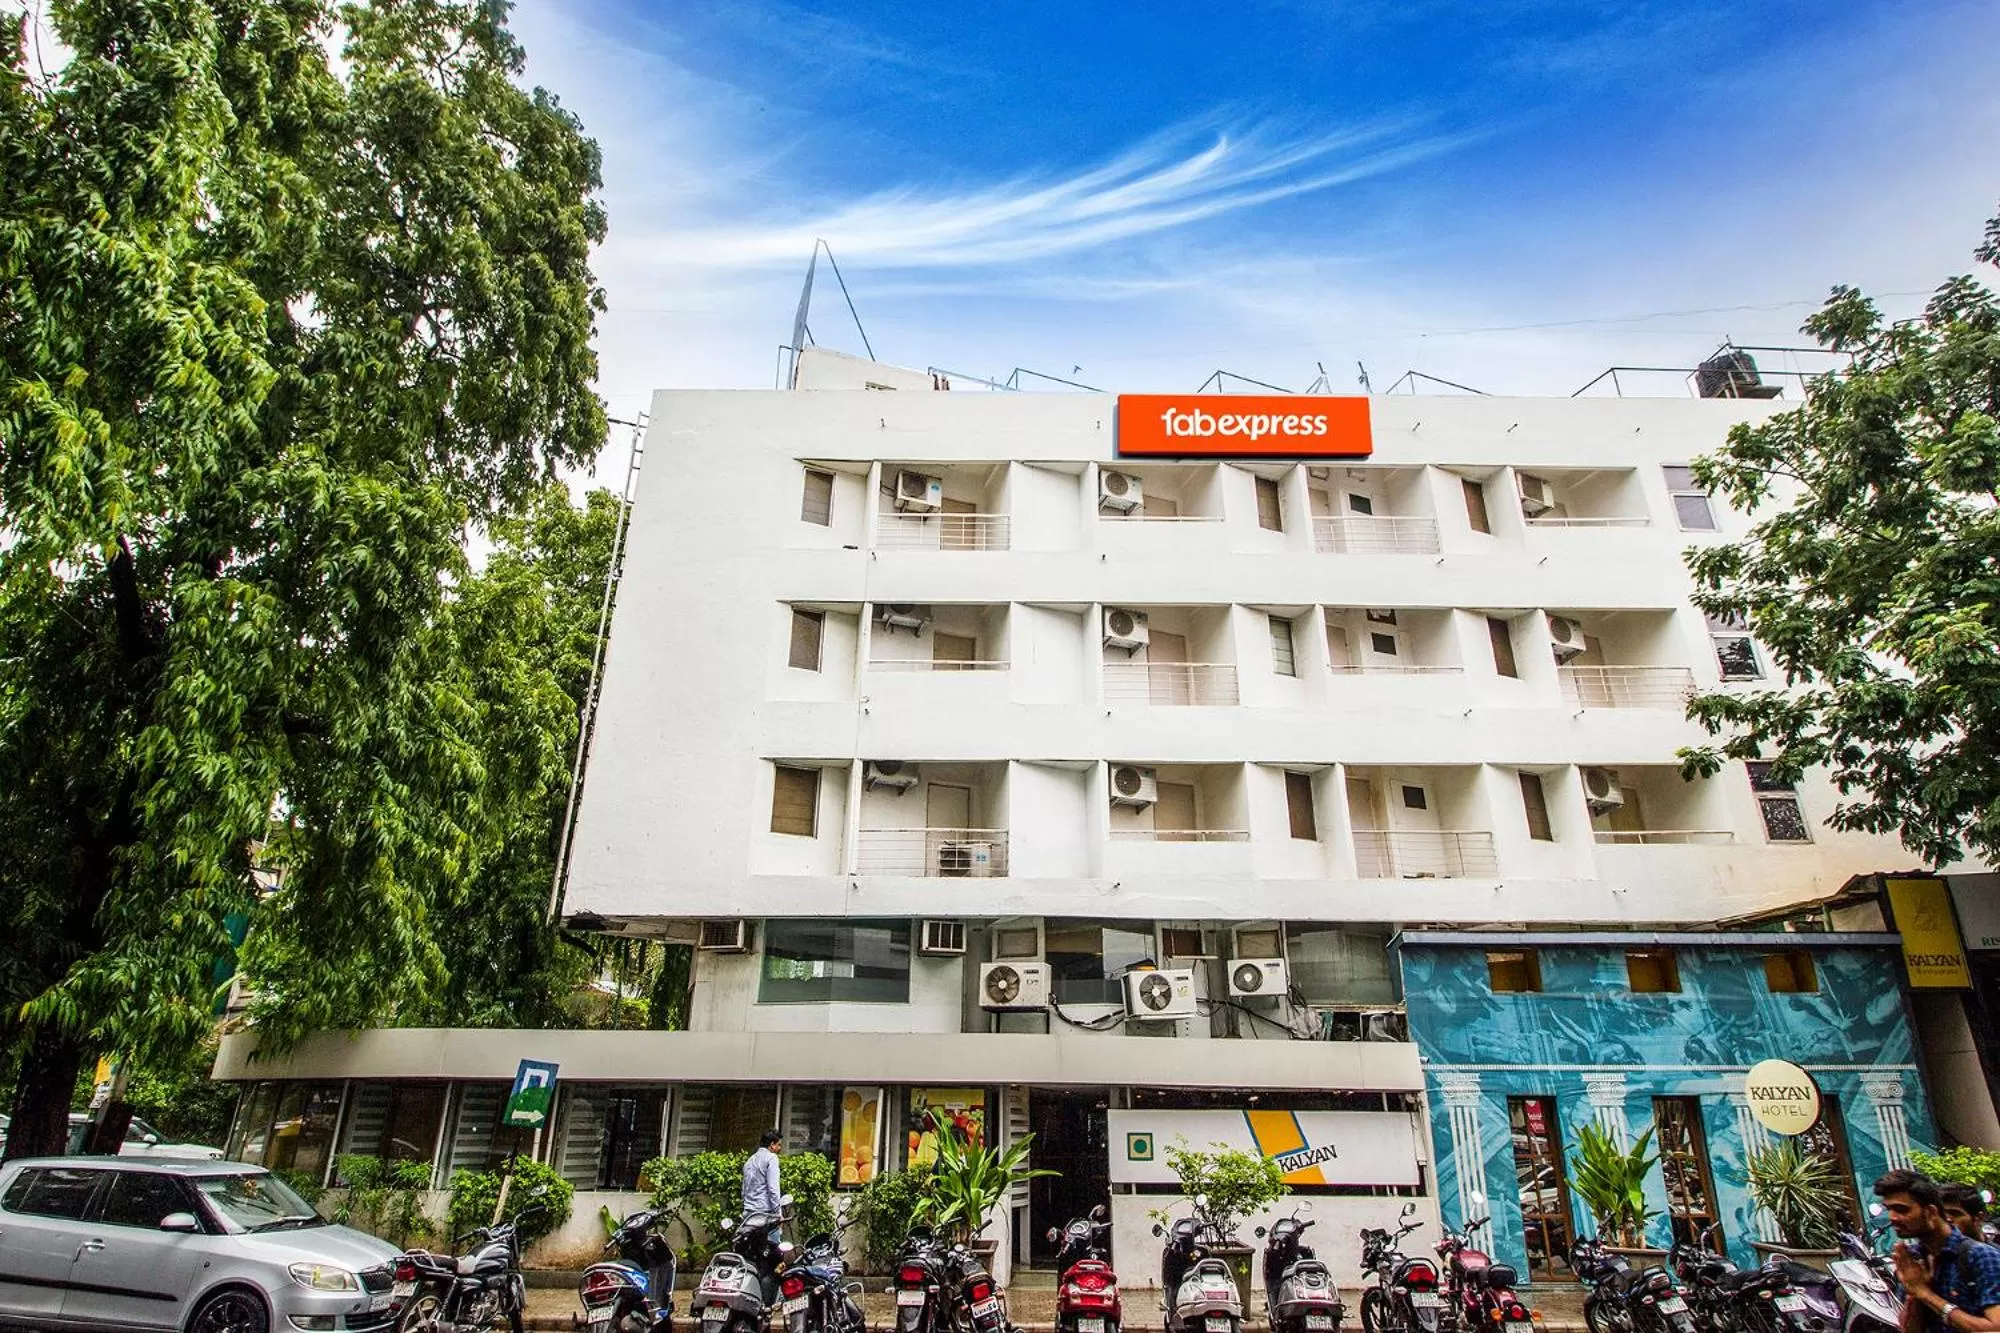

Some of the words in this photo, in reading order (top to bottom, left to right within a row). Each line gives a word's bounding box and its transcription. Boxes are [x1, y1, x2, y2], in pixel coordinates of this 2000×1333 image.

[1161, 407, 1328, 440] fabexpress
[1908, 954, 1961, 966] KALYAN
[1750, 1086, 1811, 1101] KALYAN
[1762, 1104, 1807, 1117] HOTEL
[1278, 1144, 1338, 1174] KALYAN
